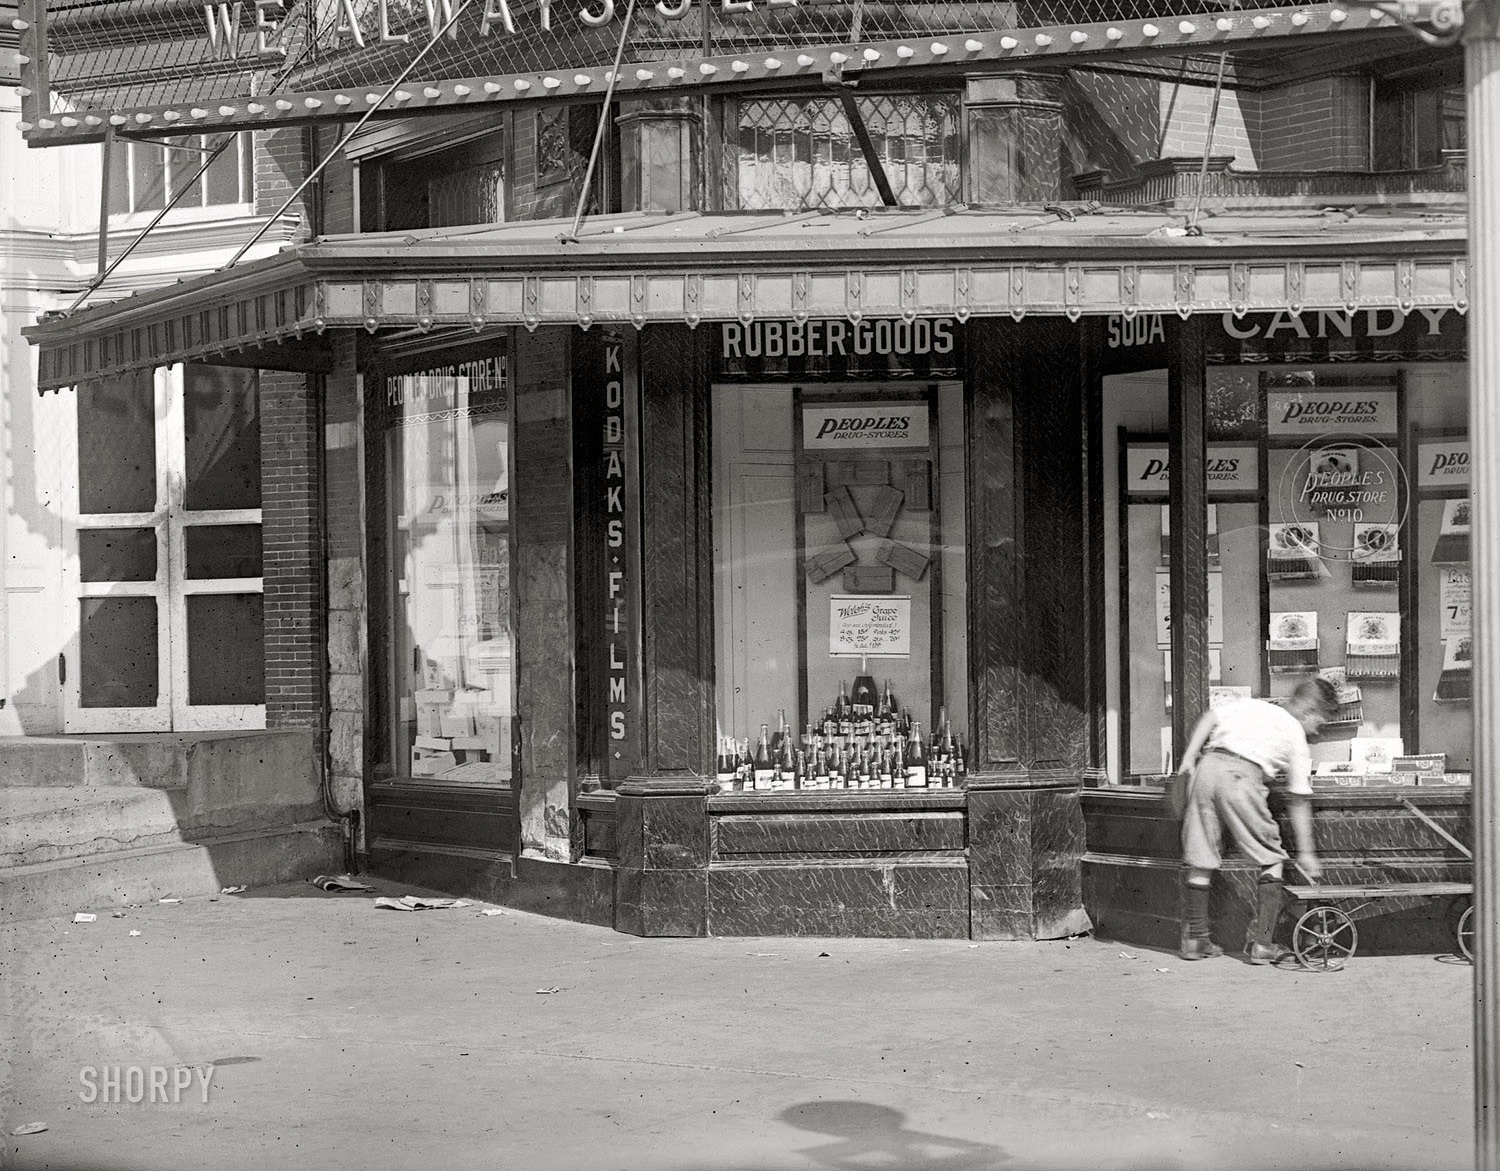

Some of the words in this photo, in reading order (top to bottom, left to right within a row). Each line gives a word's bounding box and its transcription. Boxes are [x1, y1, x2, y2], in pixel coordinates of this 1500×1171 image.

[721, 319, 846, 358] RUBBER
[853, 317, 955, 355] GOODS
[1107, 314, 1166, 349] SODA
[1221, 308, 1453, 340] CANDY
[815, 415, 912, 440] PEOPLES
[1280, 401, 1380, 424] PEOPLES
[603, 343, 625, 549] KODAKS
[1299, 470, 1385, 503] PEOPLES
[1311, 490, 1345, 504] DRUG
[1346, 490, 1388, 504] STORE
[608, 571, 627, 742] FILMS
